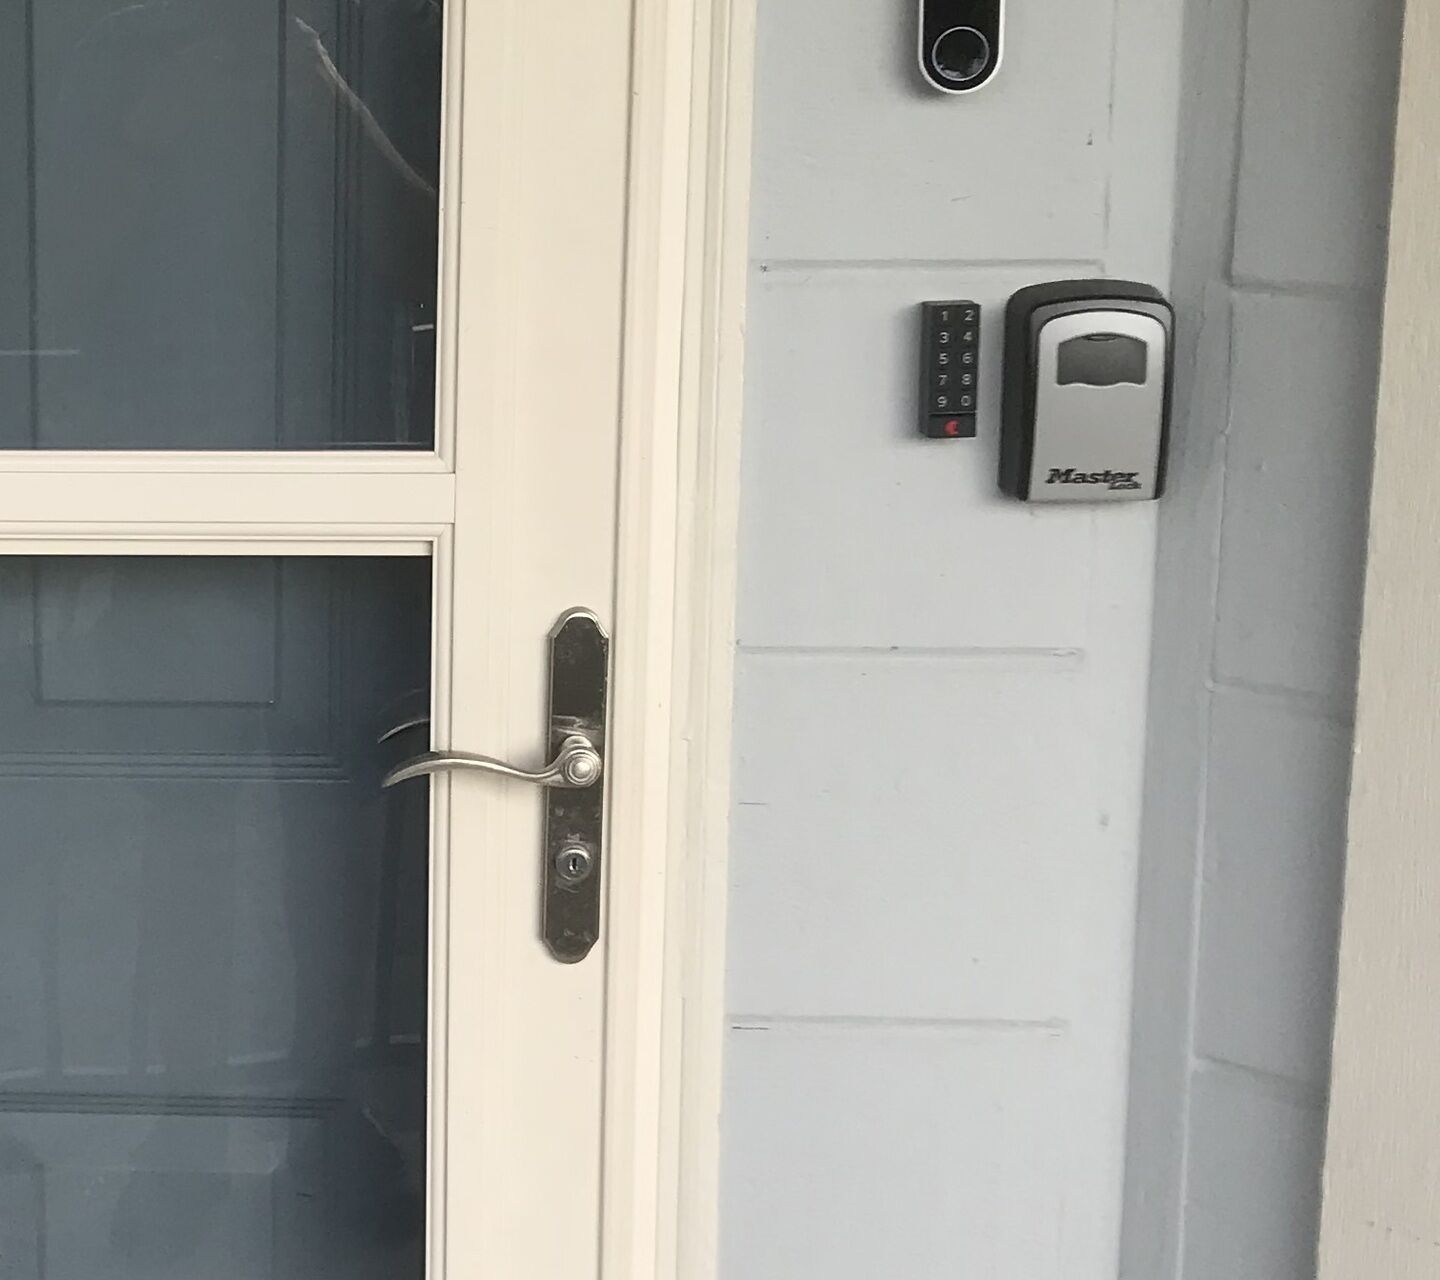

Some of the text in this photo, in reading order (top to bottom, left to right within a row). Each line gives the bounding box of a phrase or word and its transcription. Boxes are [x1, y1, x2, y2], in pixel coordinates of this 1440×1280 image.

[942, 309, 974, 321] 1 2
[939, 331, 972, 344] 3 4
[939, 352, 973, 365] 5 6
[938, 373, 972, 386] 7 8
[937, 396, 948, 408] 9
[1045, 468, 1139, 484] Master
